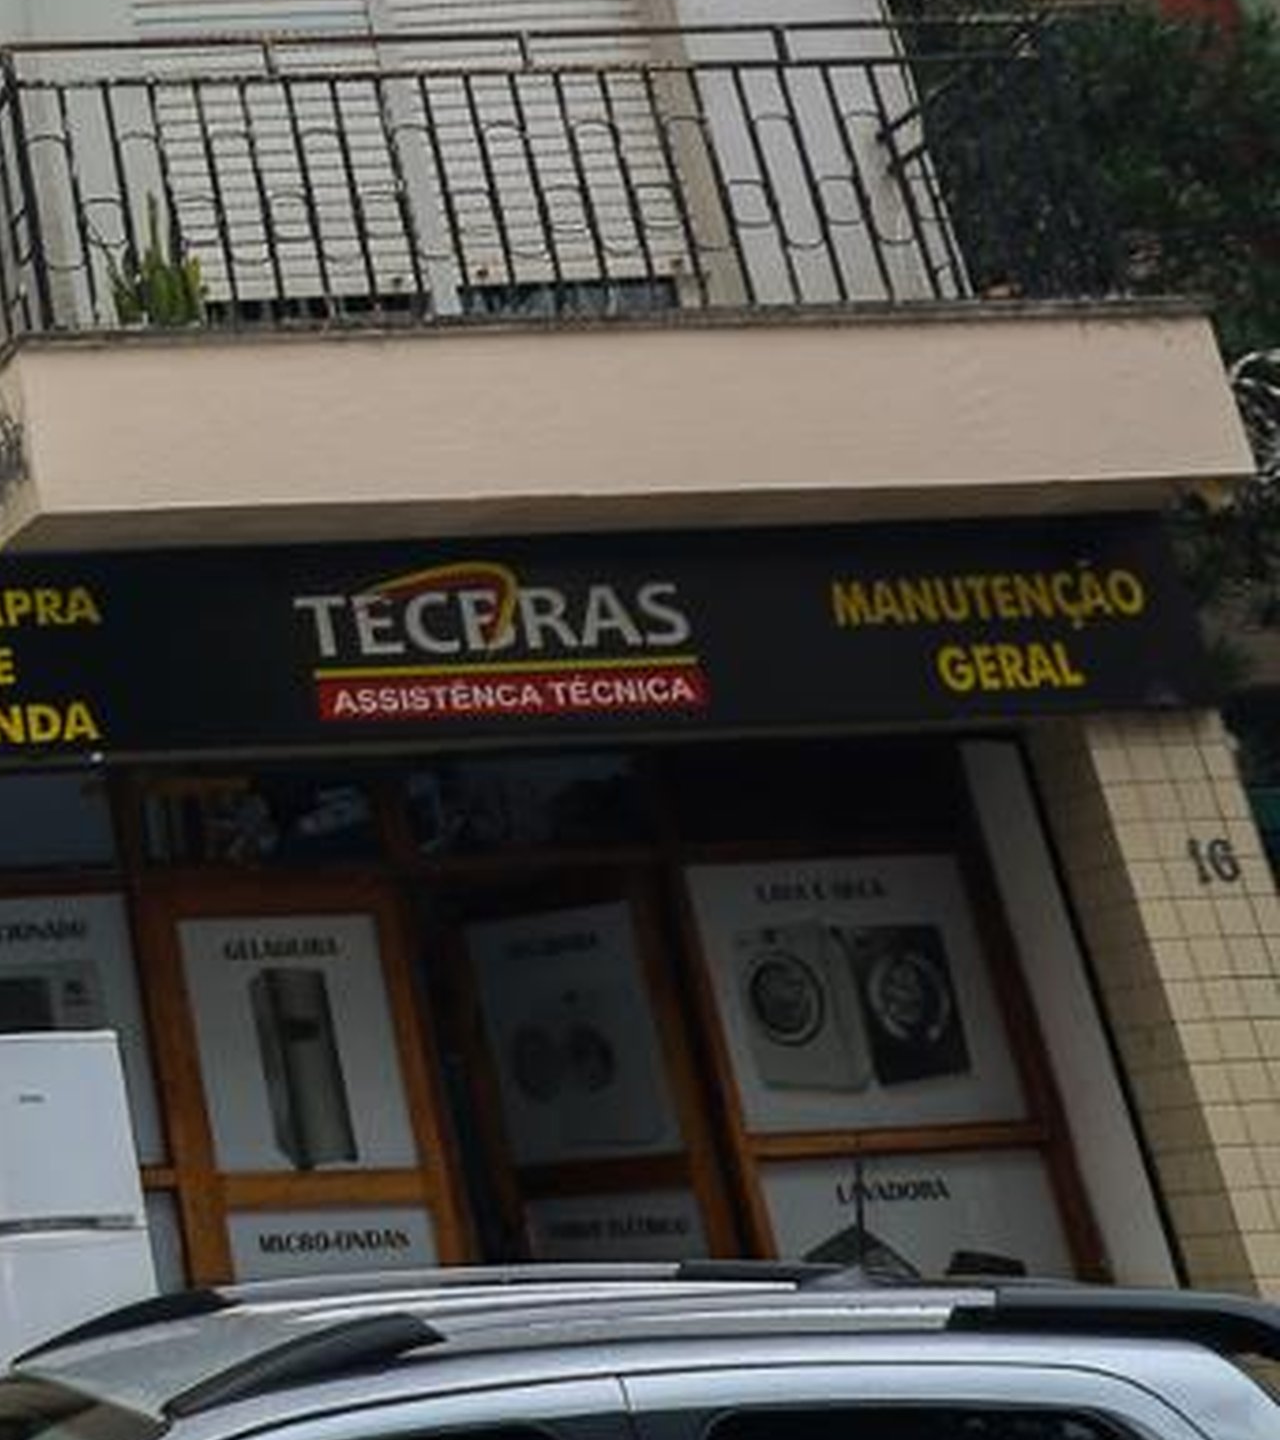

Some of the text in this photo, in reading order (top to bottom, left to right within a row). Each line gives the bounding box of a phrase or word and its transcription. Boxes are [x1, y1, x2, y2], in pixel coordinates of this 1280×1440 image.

[293, 582, 692, 656] TECBRAS
[831, 561, 1142, 630] MANUTENÇÃO
[551, 674, 696, 707] TÉCNICA
[939, 642, 1084, 692] GERAL
[1188, 839, 1241, 884] 16
